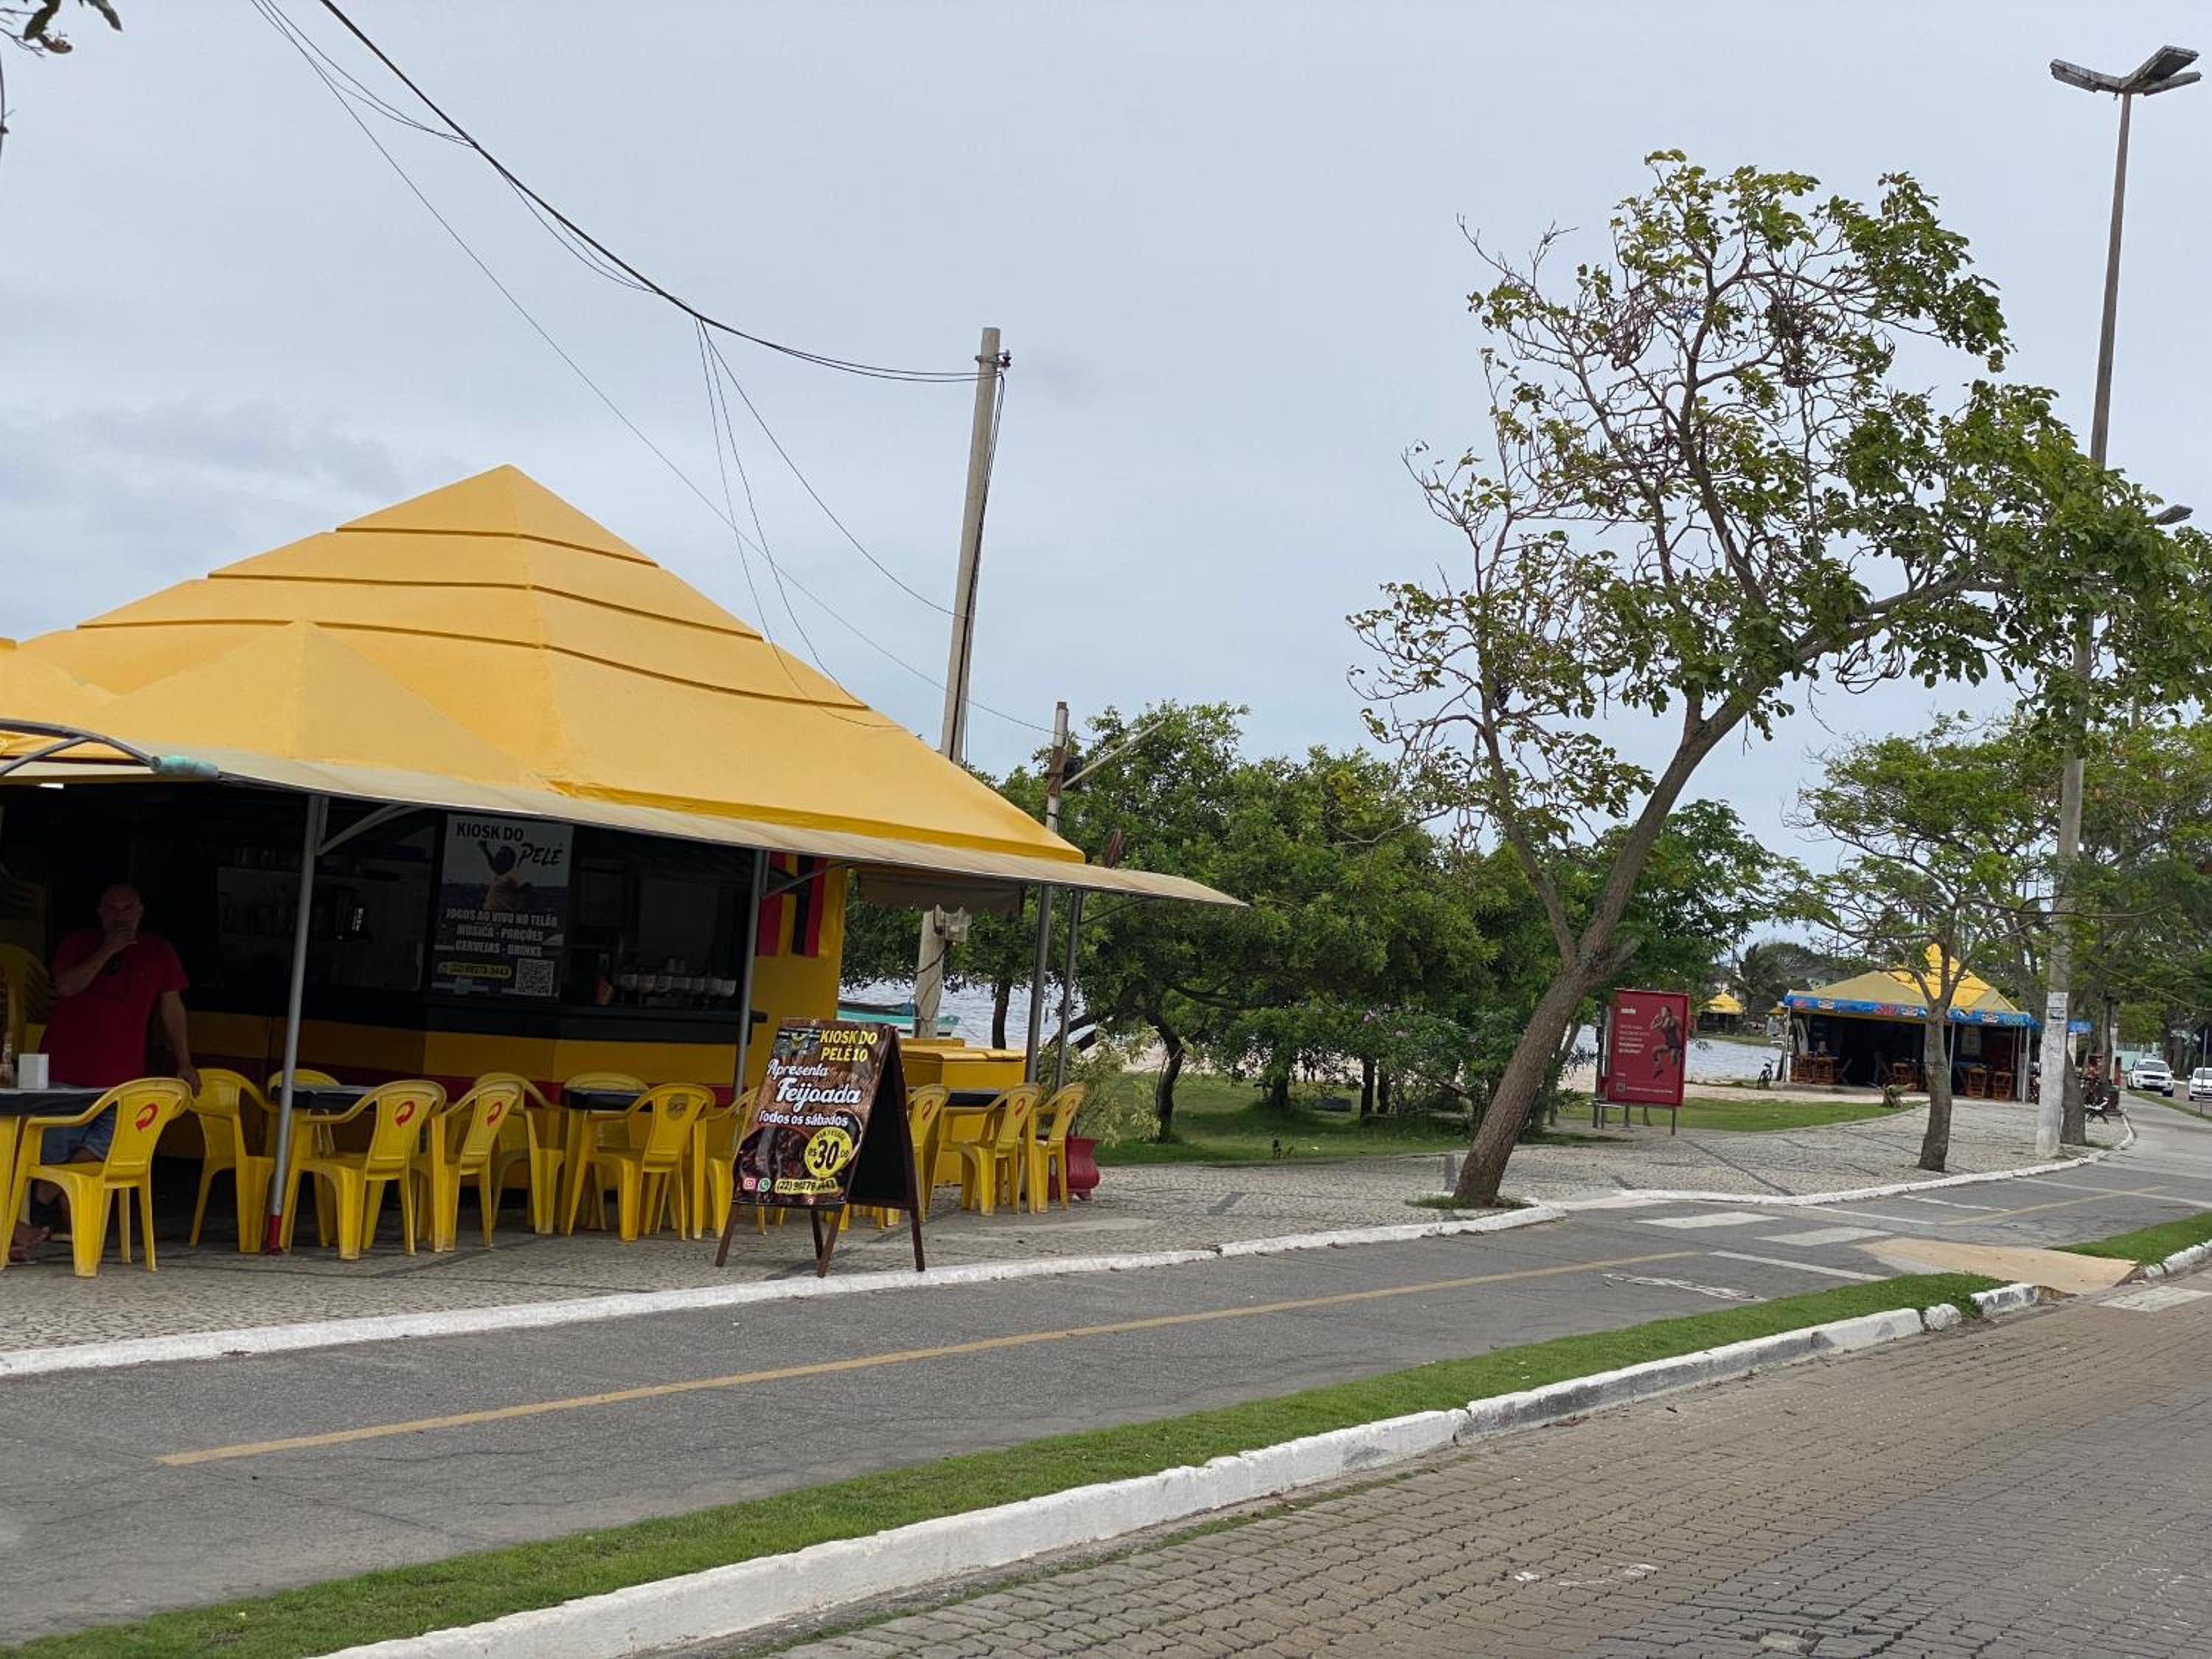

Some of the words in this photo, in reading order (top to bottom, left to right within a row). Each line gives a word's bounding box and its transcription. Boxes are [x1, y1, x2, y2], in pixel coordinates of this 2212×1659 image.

[456, 822, 501, 840] KIOSK
[504, 829, 524, 842] DO
[446, 908, 476, 921] JOGOS
[478, 911, 491, 921] AO
[492, 911, 514, 922] VIVO
[530, 911, 557, 928] TELÃO
[455, 940, 501, 954] CERVEJAS
[507, 943, 543, 957] DRINKS
[820, 1030, 858, 1044] KIOSK
[858, 1031, 877, 1045] DO
[821, 1045, 852, 1061] PELÉ
[852, 1048, 869, 1062] 10
[767, 1058, 827, 1080] Apresenta
[776, 1077, 862, 1113] Feijoada
[759, 1110, 790, 1124] Todos
[791, 1116, 804, 1124] os
[804, 1113, 849, 1127] sábados
